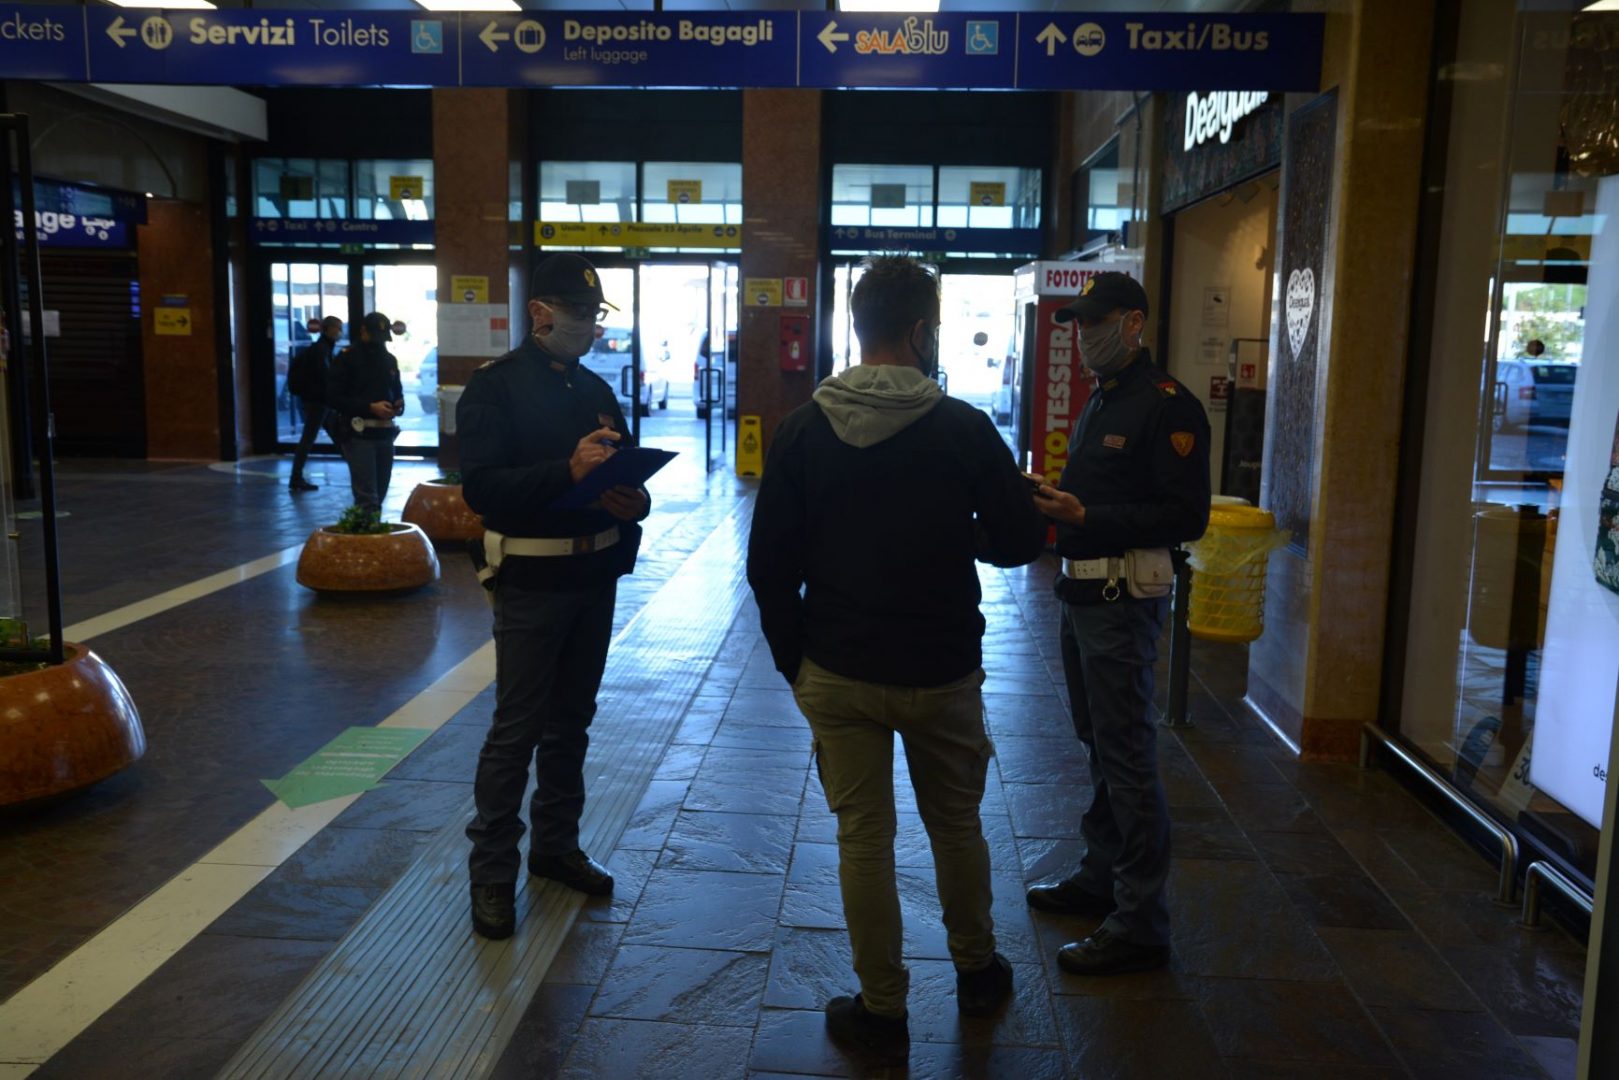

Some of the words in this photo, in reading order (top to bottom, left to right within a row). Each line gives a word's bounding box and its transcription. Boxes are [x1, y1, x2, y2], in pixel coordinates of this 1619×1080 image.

[0, 12, 65, 42] ckets
[189, 18, 296, 46] Servizi
[308, 19, 390, 48] Toilets
[563, 18, 671, 47] Deposito
[678, 18, 774, 47] Bagagli
[1126, 21, 1270, 53] Taxi/Bus
[563, 47, 586, 61] Left
[590, 47, 648, 63] luggage
[284, 220, 308, 231] Taxi
[341, 220, 379, 232] Centro
[864, 230, 886, 240] Bus
[887, 230, 937, 241] Terminal
